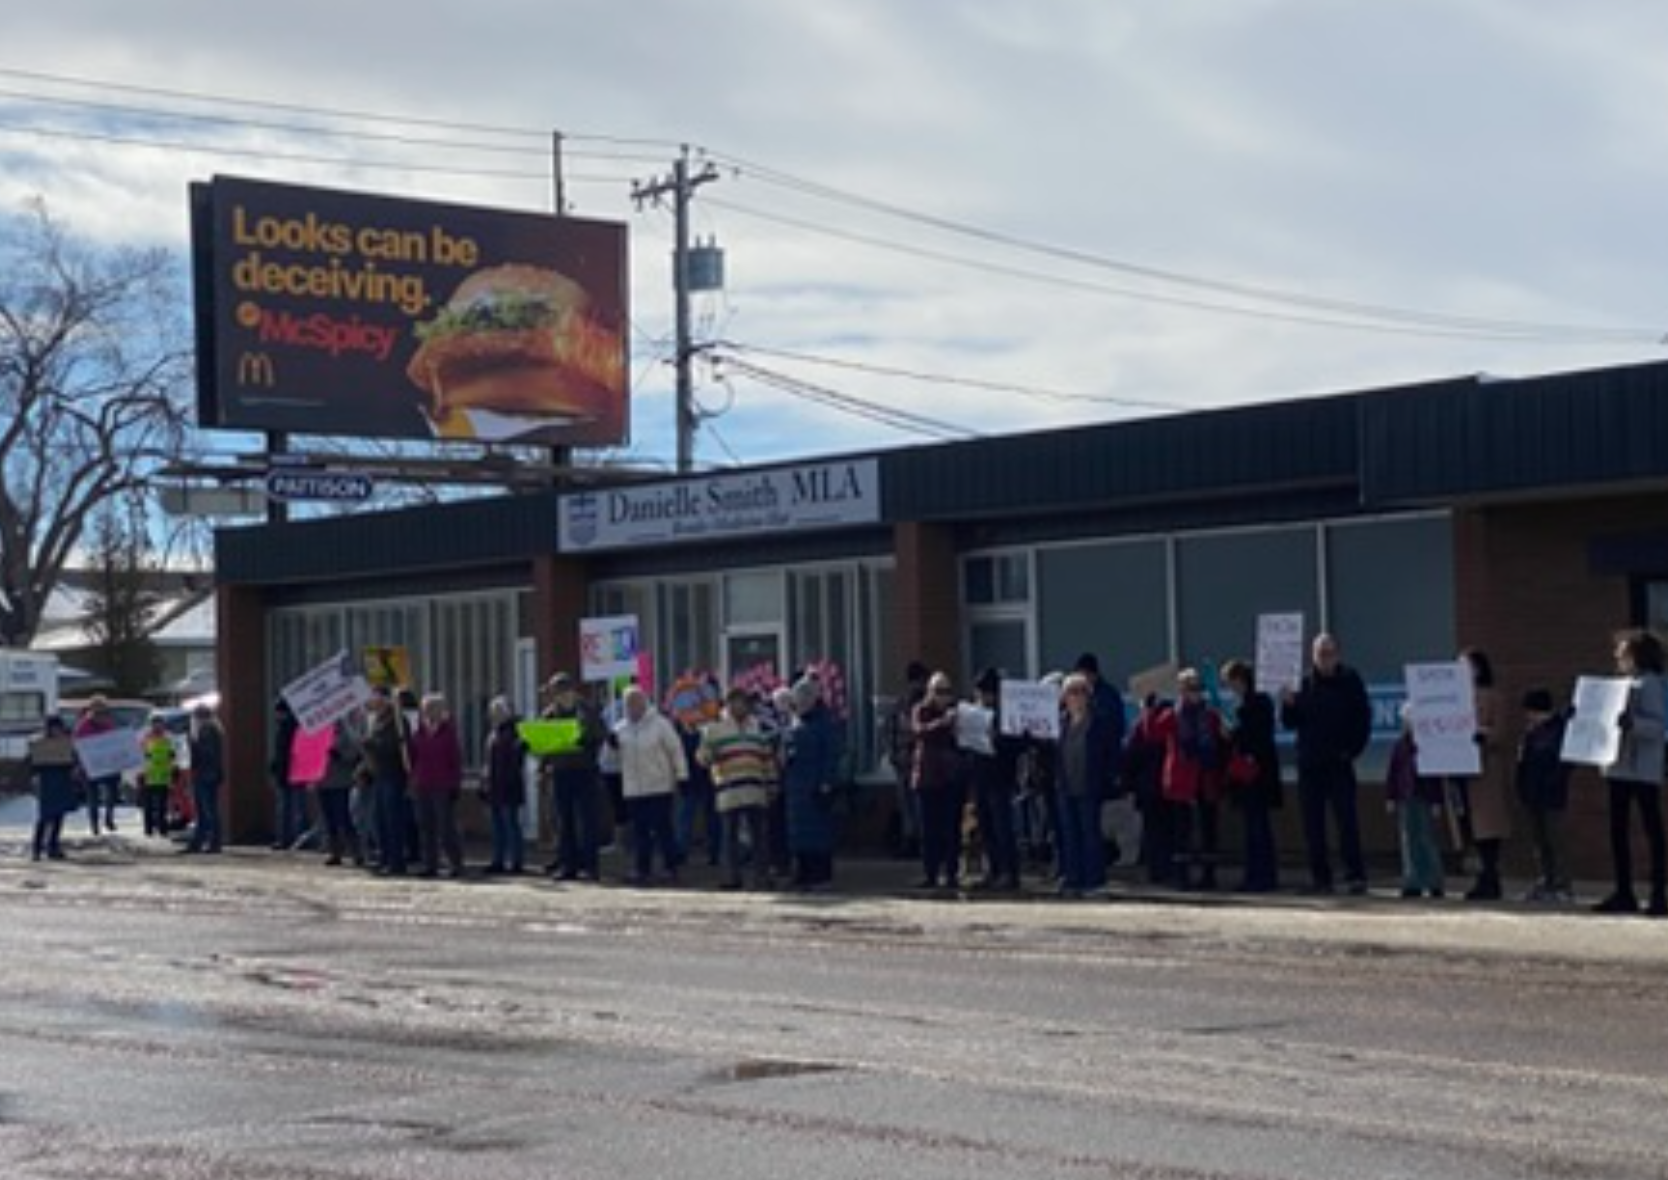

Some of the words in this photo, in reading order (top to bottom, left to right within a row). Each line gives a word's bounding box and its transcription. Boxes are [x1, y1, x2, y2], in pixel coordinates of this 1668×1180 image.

[234, 206, 350, 252] Looks
[358, 229, 425, 259] can
[435, 227, 477, 265] be
[234, 253, 431, 314] deceiving.
[260, 310, 395, 360] McSpicy
[275, 477, 365, 496] PATTISON
[608, 486, 700, 525] Danielle
[707, 475, 778, 513] Smith
[791, 466, 862, 506] MLA
